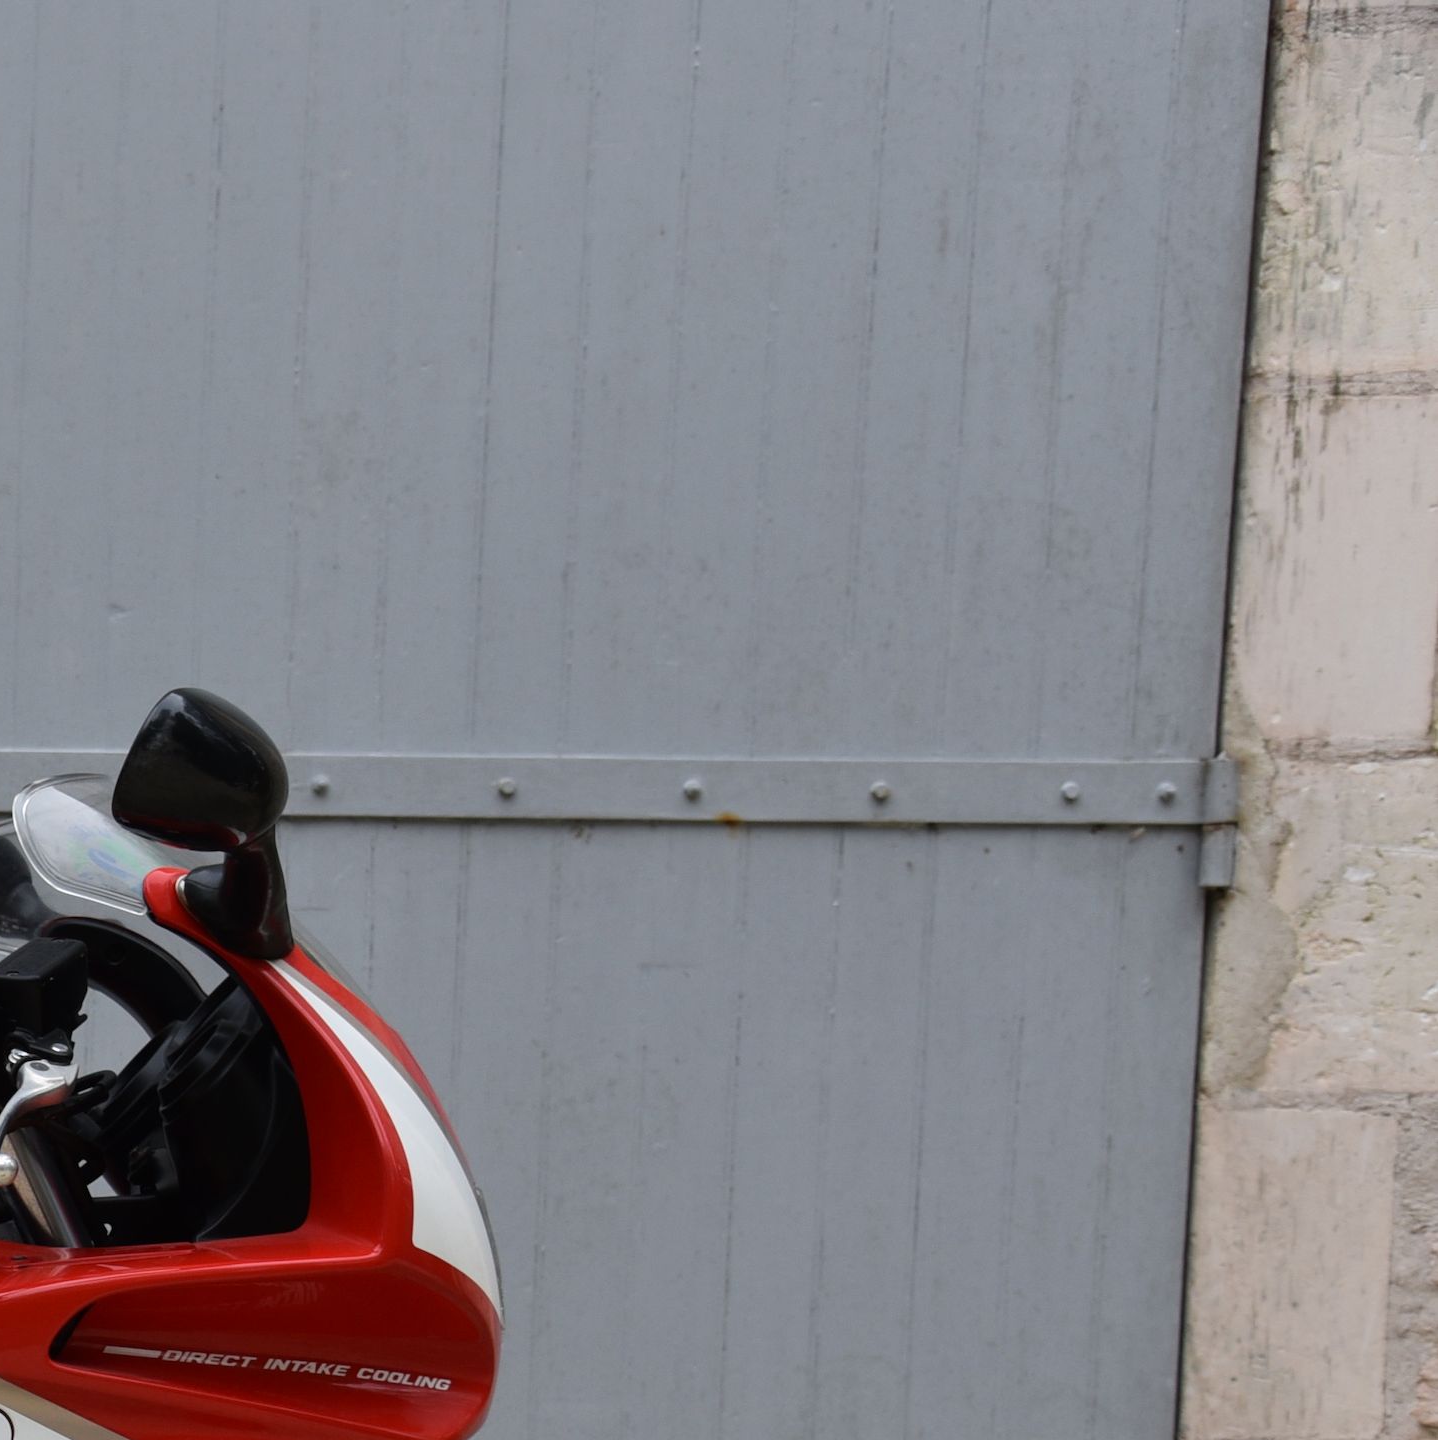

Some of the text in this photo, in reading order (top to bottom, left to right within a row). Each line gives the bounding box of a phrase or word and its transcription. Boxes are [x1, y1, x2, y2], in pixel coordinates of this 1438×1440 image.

[162, 1349, 451, 1391] DIRECT INTAKE COOLING
